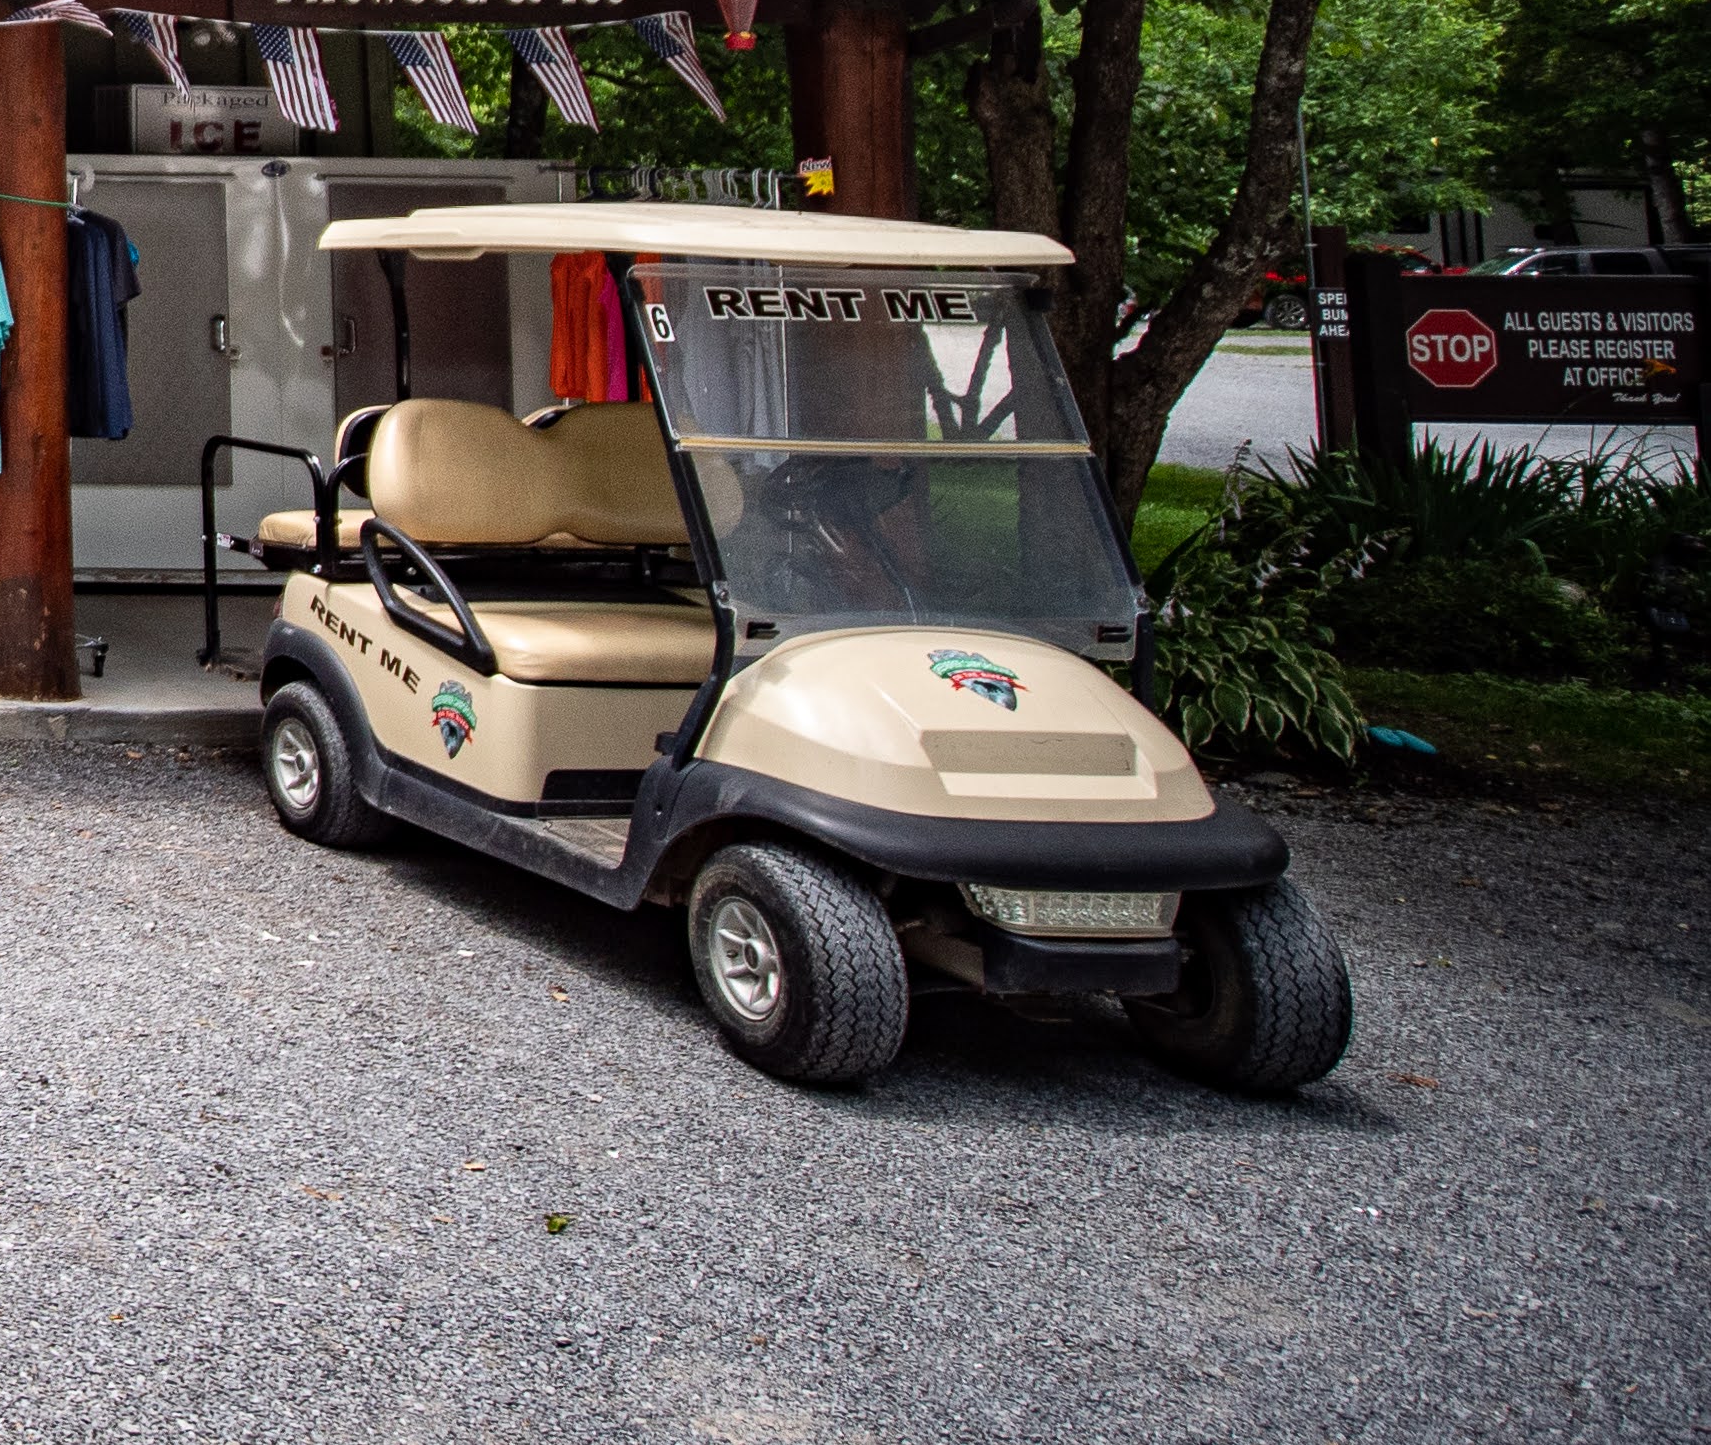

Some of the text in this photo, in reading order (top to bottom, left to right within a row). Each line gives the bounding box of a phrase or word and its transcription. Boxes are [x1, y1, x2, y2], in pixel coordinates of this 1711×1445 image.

[169, 118, 262, 152] ICE
[703, 286, 978, 322] RENT ME
[1317, 292, 1347, 305] SPE
[650, 306, 670, 339] 6
[1504, 312, 1695, 332] ALL GUESTS & VISITORS
[1412, 334, 1491, 362] STOP
[1529, 339, 1676, 359] PLEASE REGISTER
[1563, 367, 1646, 386] AT OFFICE
[1612, 392, 1647, 403] Thank
[310, 594, 420, 695] RENT ME
